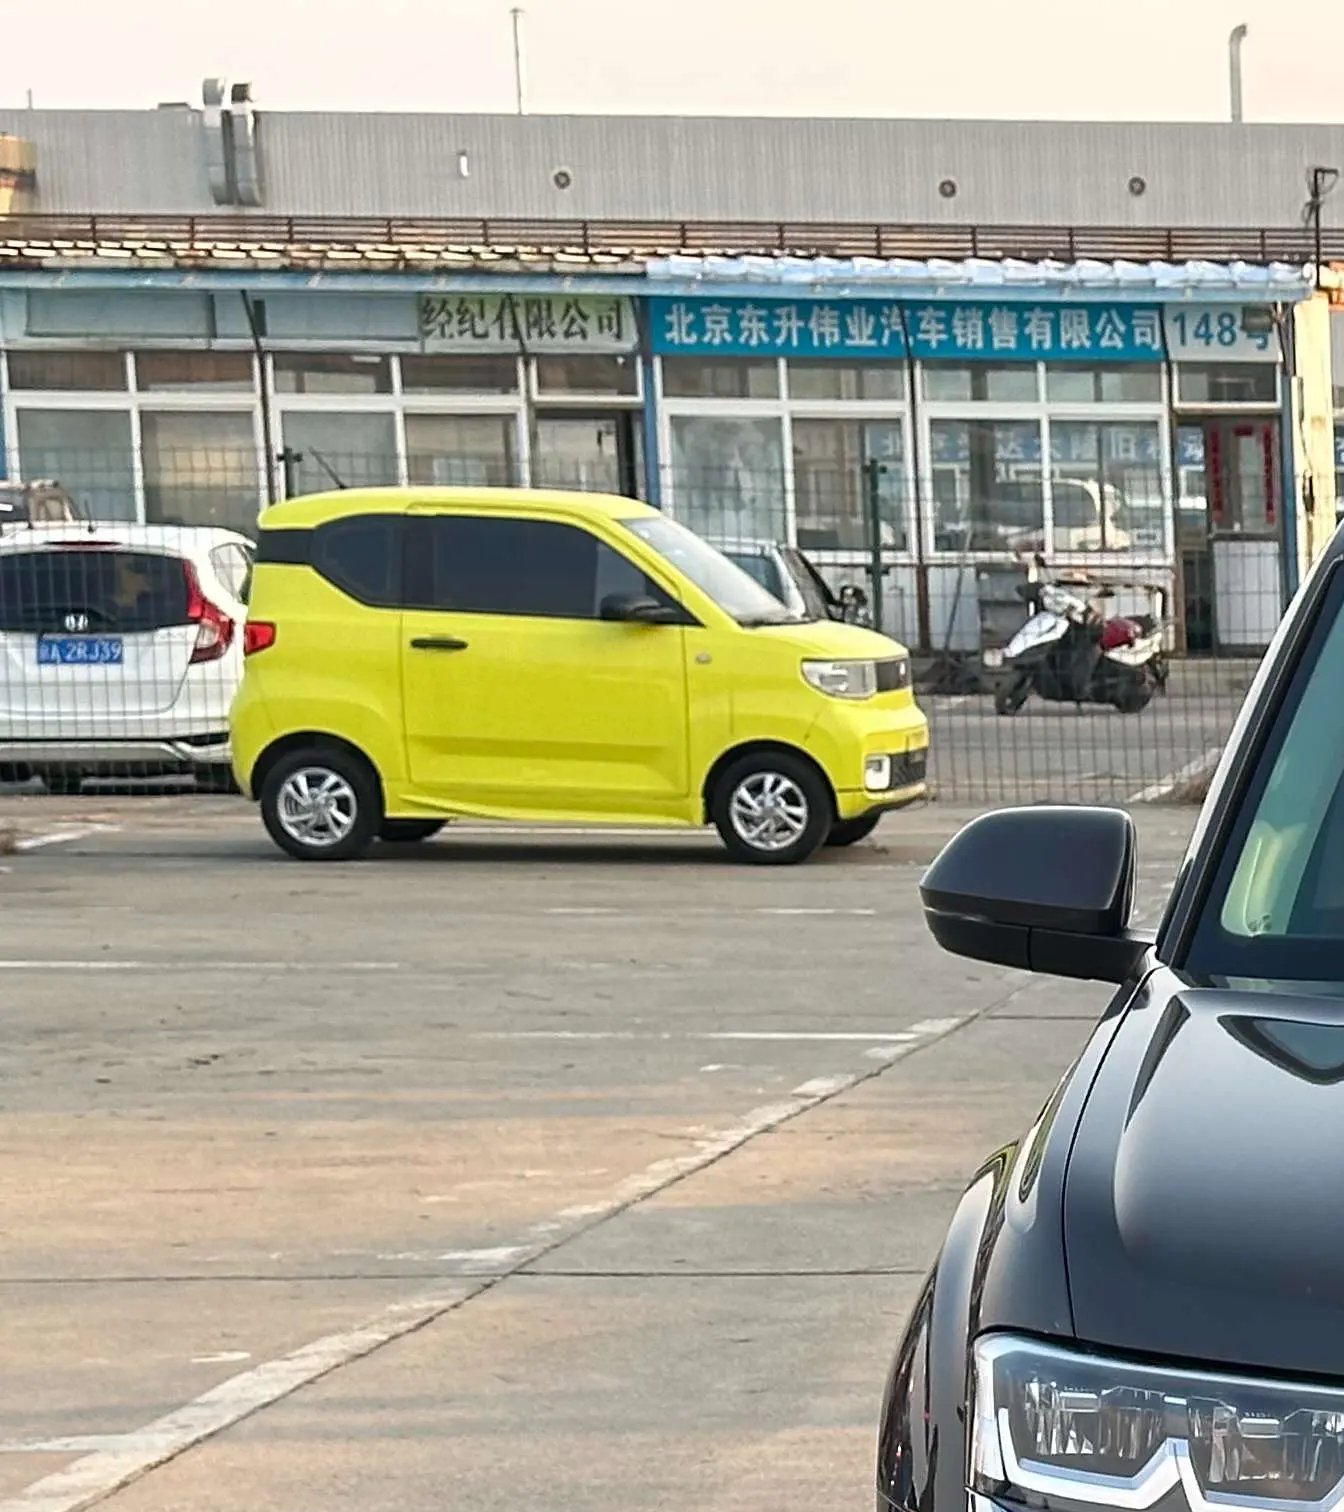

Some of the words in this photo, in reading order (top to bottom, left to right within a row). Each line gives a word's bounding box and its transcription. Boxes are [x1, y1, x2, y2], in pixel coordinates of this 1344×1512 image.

[421, 296, 623, 342] 经纪有限公司
[665, 304, 1162, 351] 北京东升伟业汽车销售有限公司
